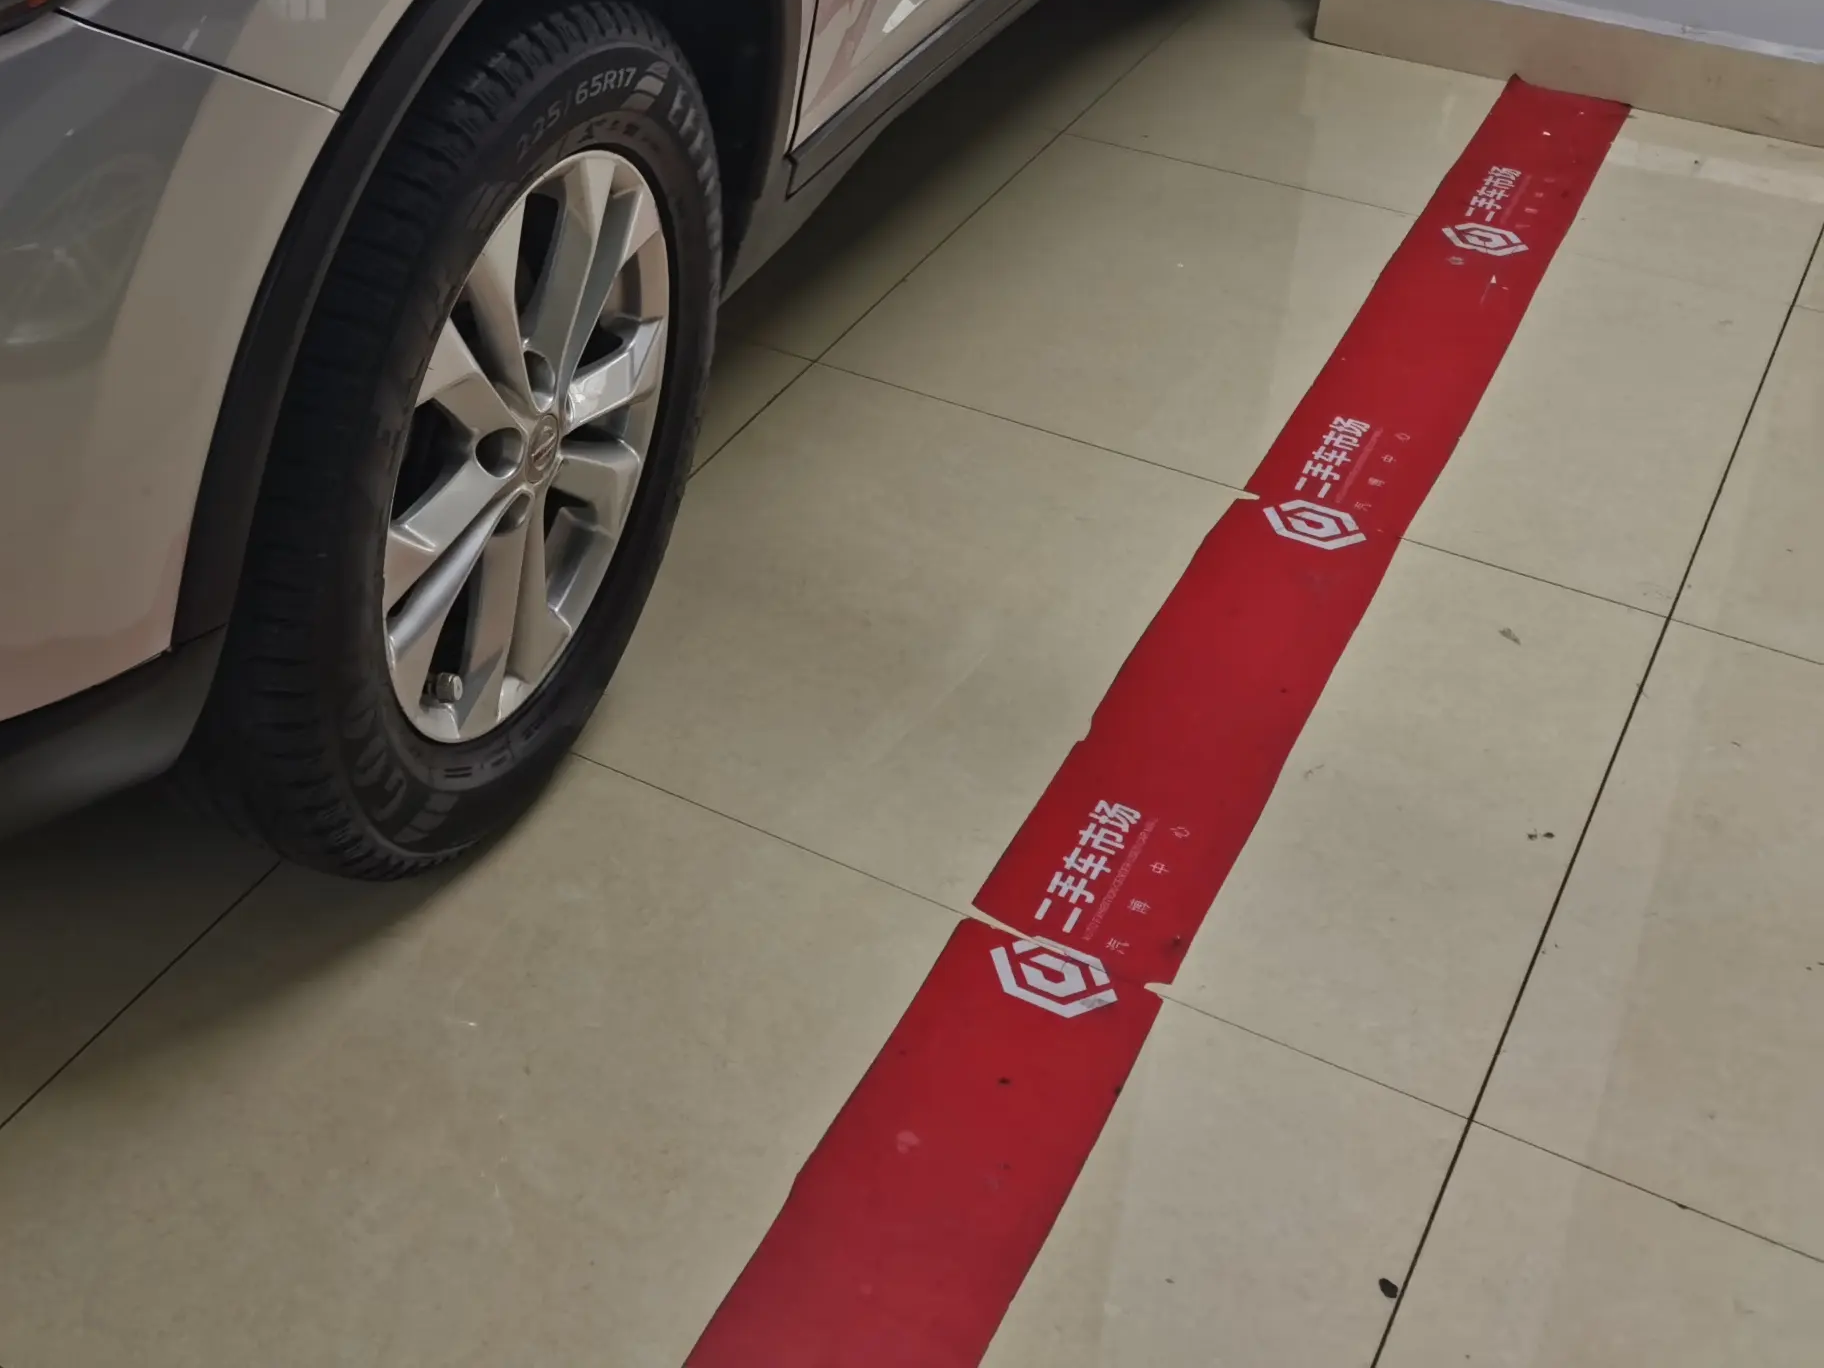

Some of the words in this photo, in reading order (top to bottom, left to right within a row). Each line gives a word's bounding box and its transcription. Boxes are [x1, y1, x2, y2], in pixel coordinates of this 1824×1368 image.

[516, 67, 637, 164] 225/65R17
[1465, 166, 1522, 223] 二手车市场
[1294, 416, 1371, 499] 二手车市场
[1034, 799, 1142, 934] 二手车市场
